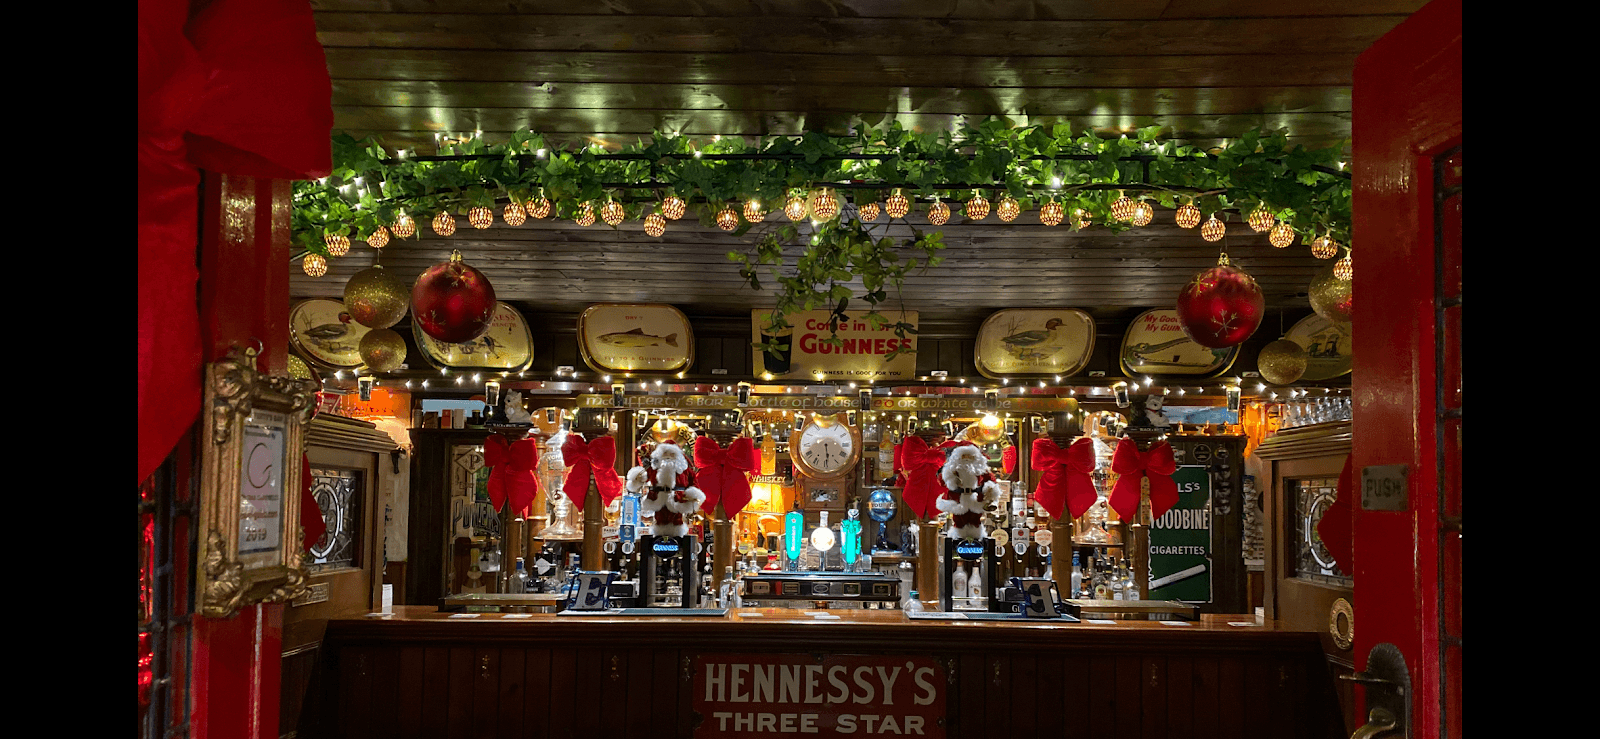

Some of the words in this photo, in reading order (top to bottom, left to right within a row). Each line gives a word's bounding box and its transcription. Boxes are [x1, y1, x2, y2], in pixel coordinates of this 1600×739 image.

[853, 319, 866, 332] in
[871, 321, 890, 332] or
[1144, 314, 1158, 323] My
[1144, 323, 1159, 333] My
[799, 332, 912, 355] GUINNESS
[749, 396, 788, 408] ottle
[813, 396, 860, 408] house
[921, 398, 968, 409] white
[469, 454, 480, 470] P
[751, 474, 786, 483] WHISKEY
[1366, 477, 1401, 498] PUSH
[452, 498, 501, 538] POWERS
[245, 526, 268, 542] 2019
[1150, 545, 1206, 555] CIGARETTES
[704, 660, 937, 706] HENNESSY'S
[713, 711, 819, 733] THREE
[835, 713, 925, 735] STAR
